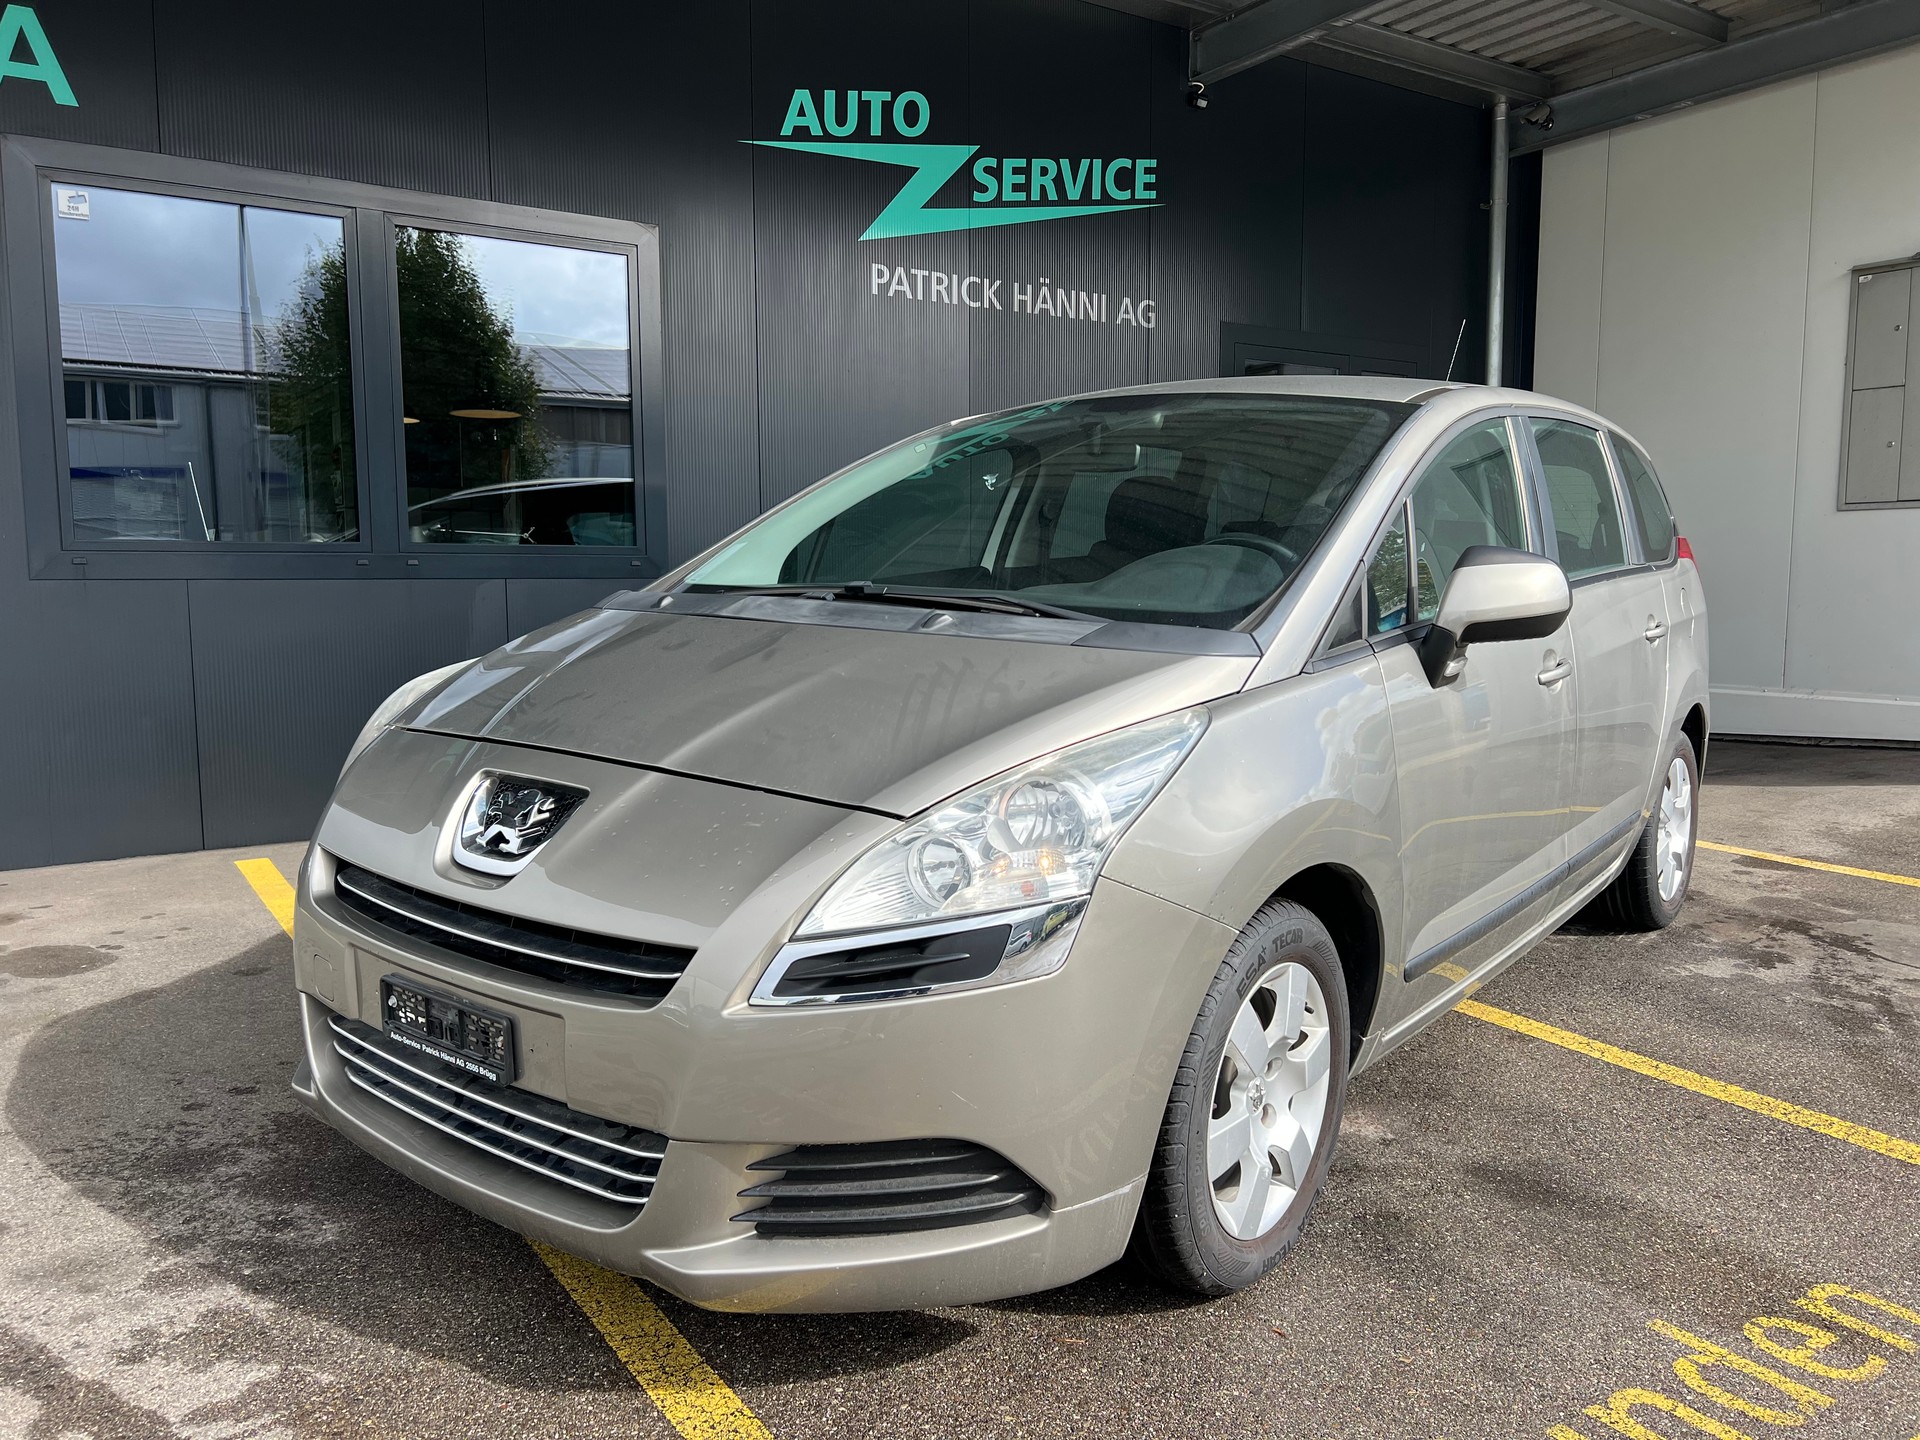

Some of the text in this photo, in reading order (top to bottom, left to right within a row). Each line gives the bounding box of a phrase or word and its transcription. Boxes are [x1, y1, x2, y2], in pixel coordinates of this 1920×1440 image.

[780, 88, 930, 137] AUTO
[972, 157, 1158, 203] SERVICE
[871, 262, 1157, 329] PATRICK HÄNNI AG
[1272, 927, 1304, 953] TECAR
[390, 1031, 421, 1050] Auto-Service
[421, 1043, 440, 1058] Patrick
[440, 1051, 456, 1064] Hänni
[456, 1057, 465, 1067] AG
[479, 1066, 497, 1081] Brügg
[1546, 1283, 1920, 1440] nden
